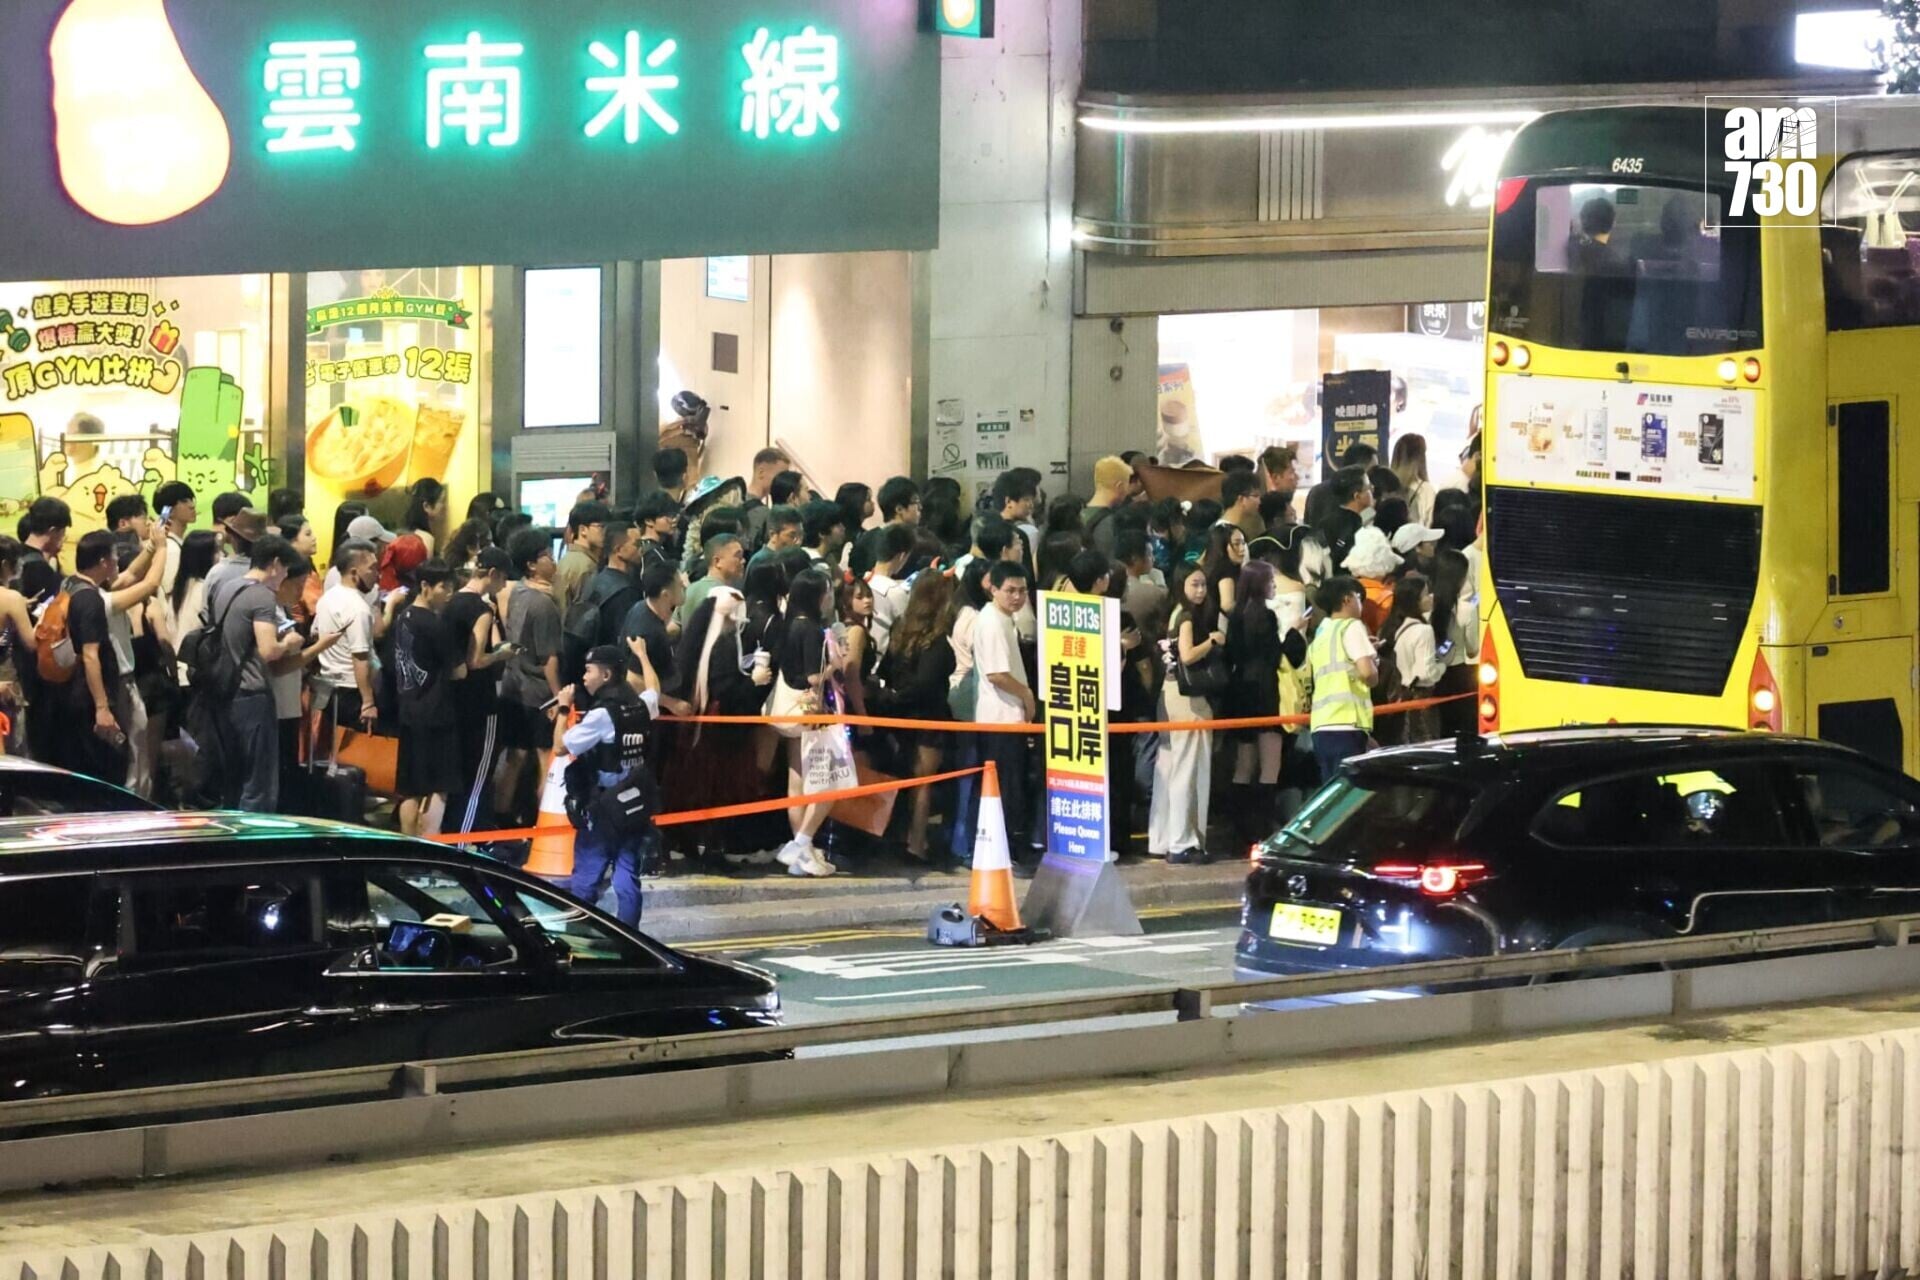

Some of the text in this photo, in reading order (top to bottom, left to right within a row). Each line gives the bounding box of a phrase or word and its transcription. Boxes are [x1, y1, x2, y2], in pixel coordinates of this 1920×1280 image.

[262, 26, 842, 153] 雲南米線
[1611, 157, 1644, 174] 6435
[31, 291, 149, 320] 健身手遊登場
[3, 353, 157, 400] 頂GYM比拼
[1048, 602, 1100, 631] B13 B13s
[1061, 635, 1088, 659] 直達
[1048, 662, 1101, 715] 皇崗
[1049, 716, 1102, 765] 口岸
[1050, 796, 1103, 822] 請在此排隊
[1053, 822, 1100, 840] Please Queue
[1067, 840, 1086, 855] Here
